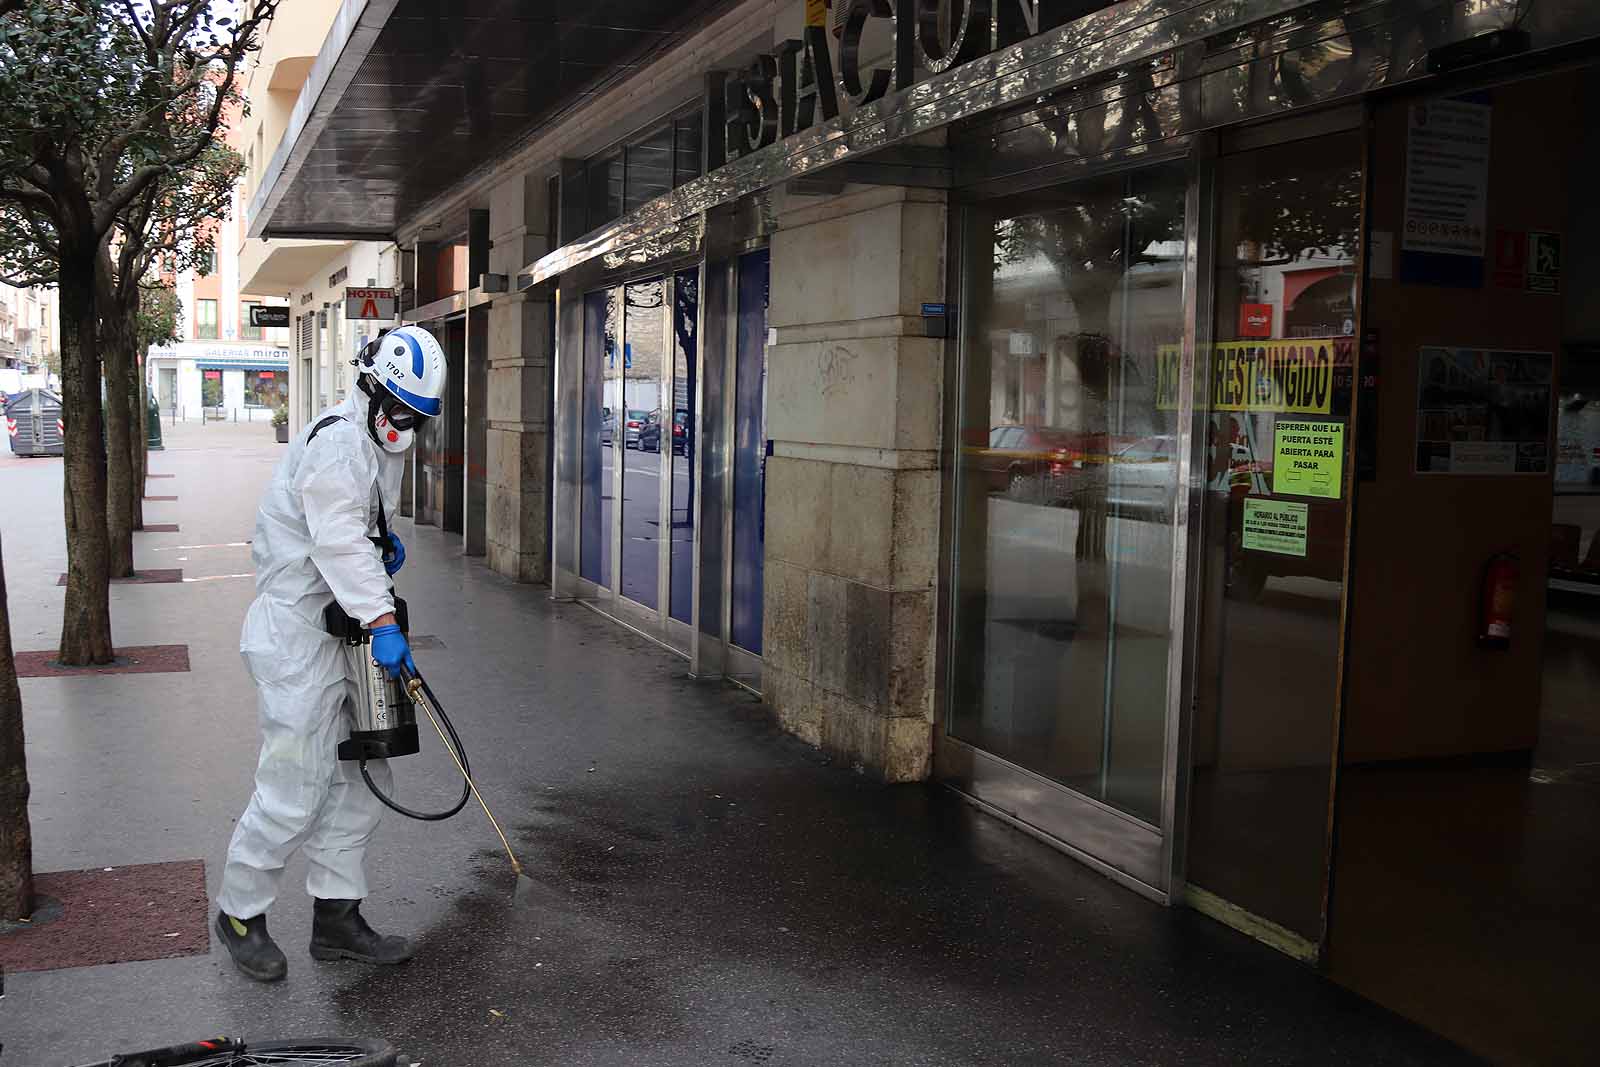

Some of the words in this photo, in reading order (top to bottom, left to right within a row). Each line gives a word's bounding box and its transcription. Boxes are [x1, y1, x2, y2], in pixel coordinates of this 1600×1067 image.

[347, 290, 393, 299] HOSTEL
[386, 361, 405, 380] 1702
[1215, 344, 1329, 409] RESTRINGIDO
[1276, 423, 1310, 432] ESPEREN
[1312, 424, 1329, 433] QUE
[1330, 425, 1341, 433] LA
[1282, 435, 1312, 445] PUERTA
[1280, 447, 1312, 457] ABIERTA
[1313, 449, 1335, 458] PARA
[1293, 460, 1319, 470] PASAR
